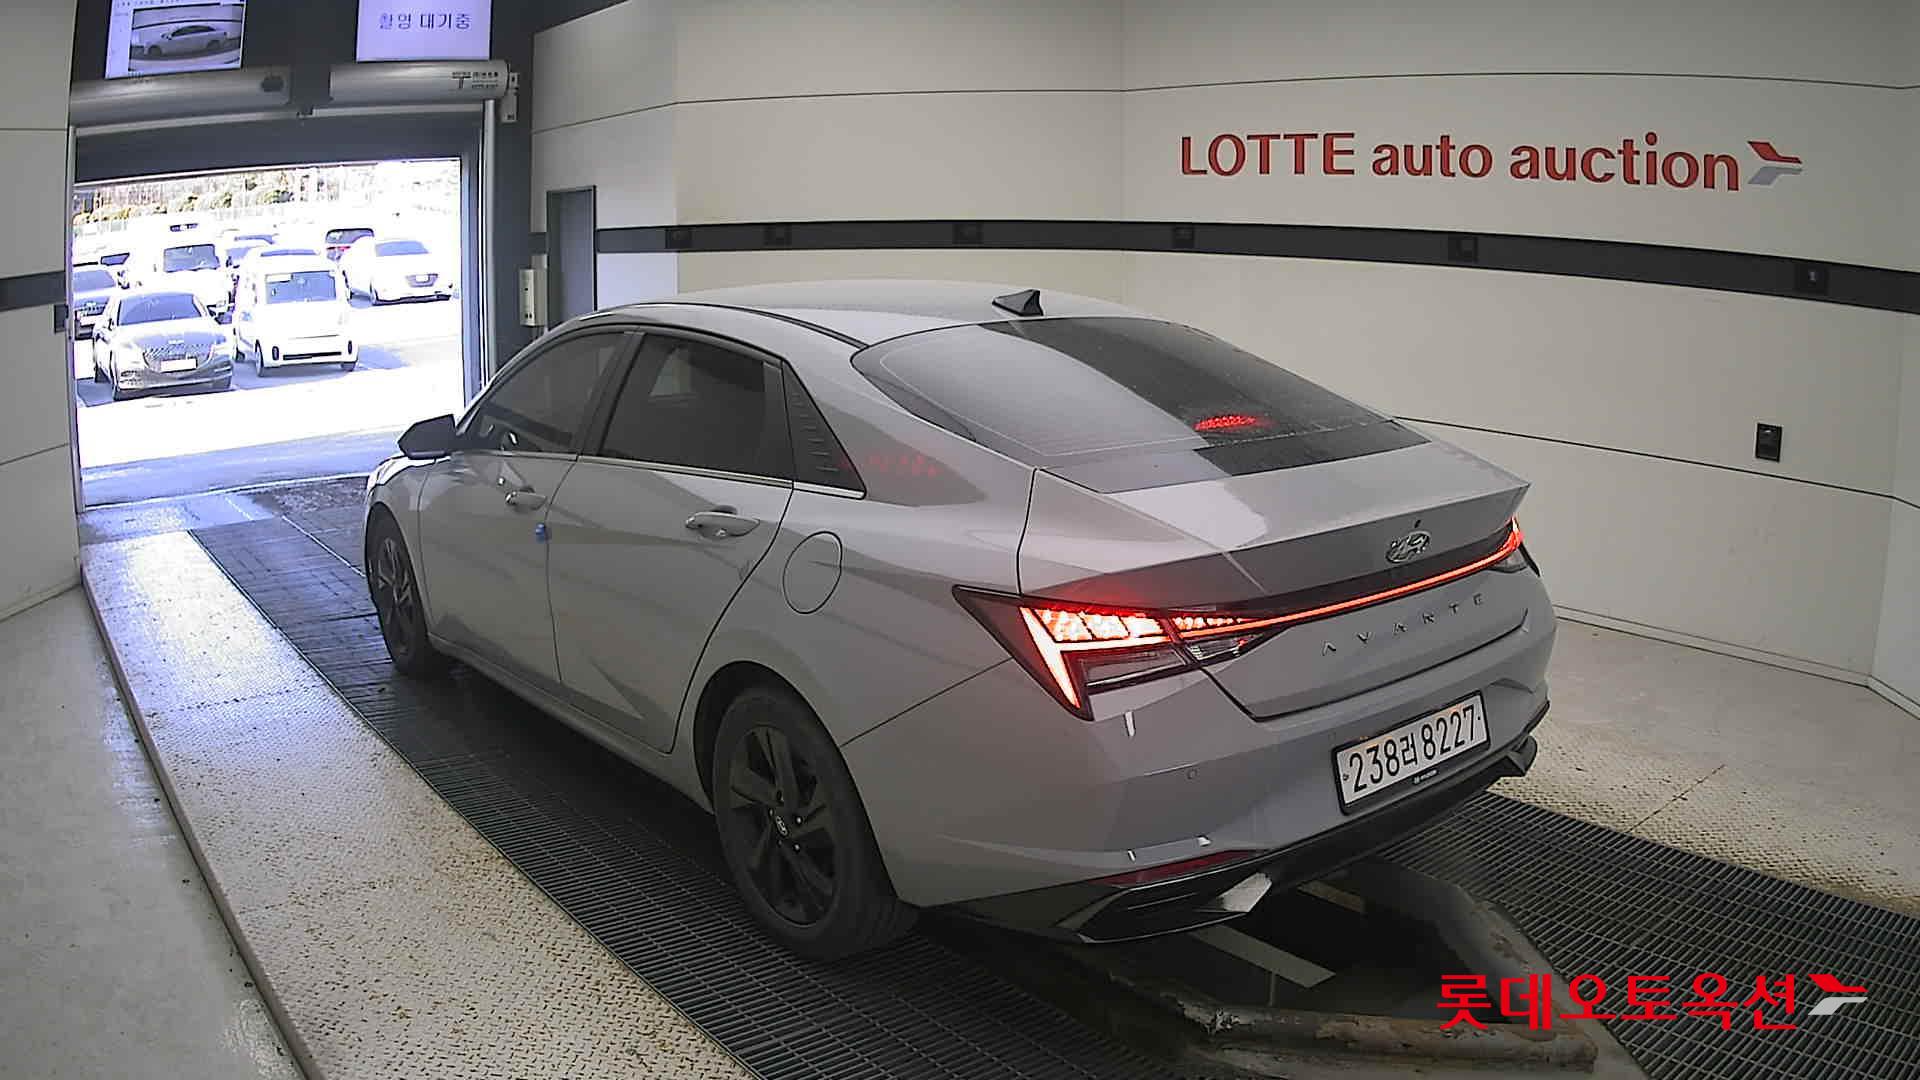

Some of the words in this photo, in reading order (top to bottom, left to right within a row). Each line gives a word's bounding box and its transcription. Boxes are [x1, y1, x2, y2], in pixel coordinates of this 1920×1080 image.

[419, 13, 472, 30] 대기중
[1181, 132, 1355, 176] LOTTE
[1371, 134, 1493, 178] auto
[1509, 131, 1739, 191] auction
[1322, 593, 1482, 656] AVANTE
[1421, 704, 1475, 761] 8227
